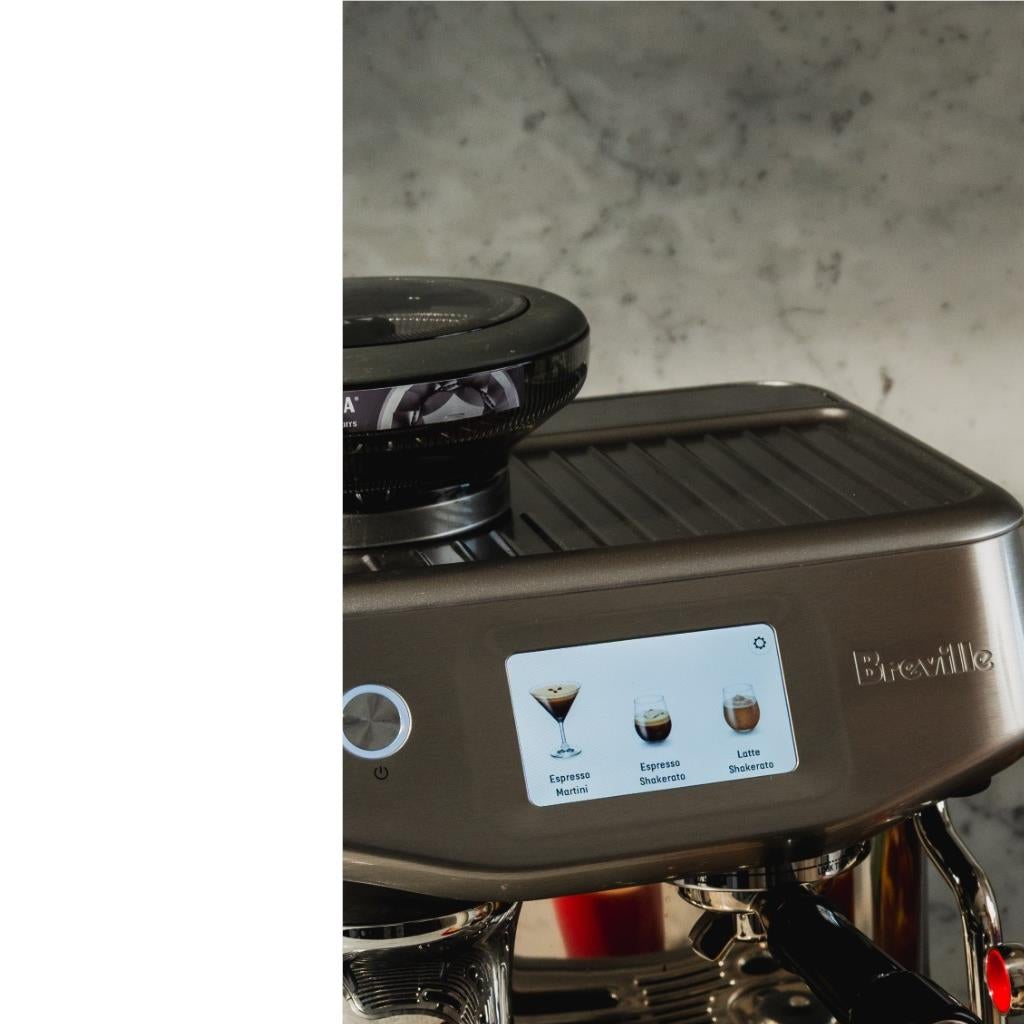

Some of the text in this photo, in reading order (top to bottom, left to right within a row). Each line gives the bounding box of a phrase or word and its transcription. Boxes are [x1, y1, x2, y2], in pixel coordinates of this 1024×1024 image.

[853, 641, 994, 686] Breville
[737, 749, 761, 759] Latte
[640, 759, 681, 772] Espresso
[728, 761, 774, 774] Shakerato
[549, 771, 591, 784] Espresso
[639, 773, 686, 786] Shakerato
[555, 784, 589, 797] Martini
